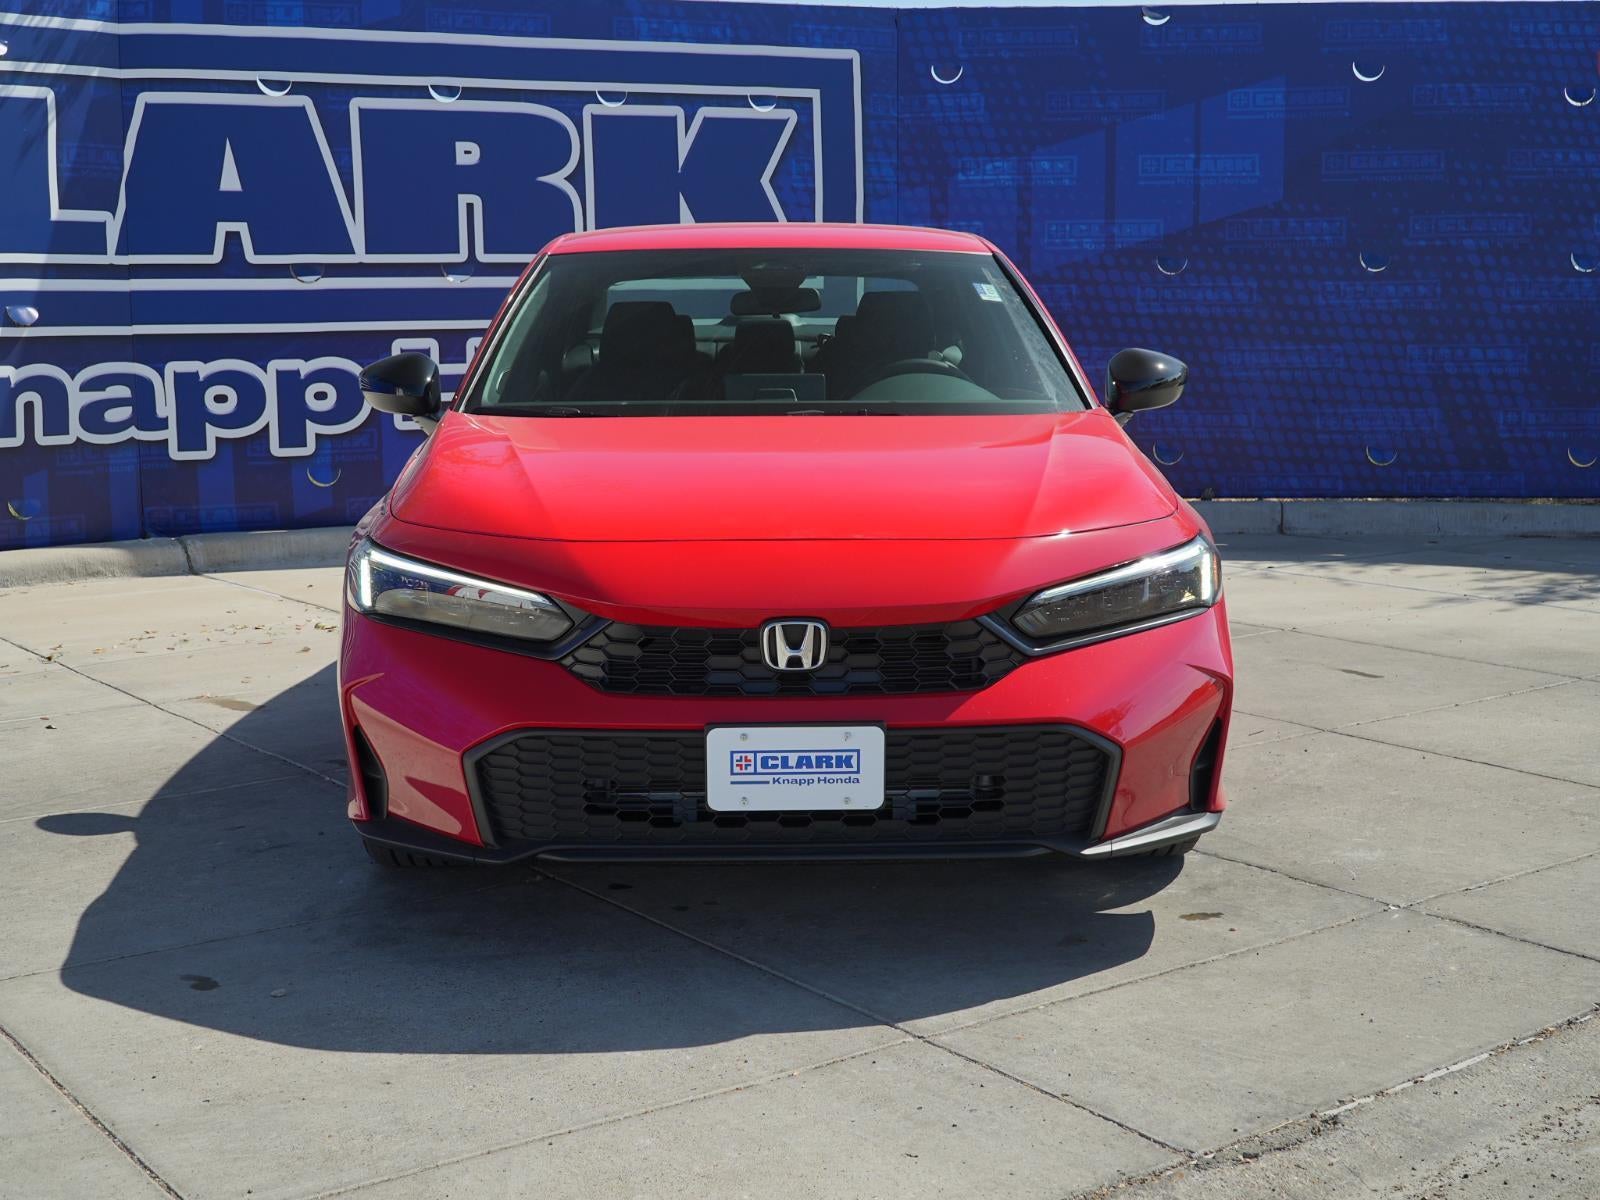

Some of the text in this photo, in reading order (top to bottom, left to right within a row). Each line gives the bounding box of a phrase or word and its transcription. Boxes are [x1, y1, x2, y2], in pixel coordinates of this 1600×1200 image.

[760, 754, 854, 770] CLARK
[772, 775, 860, 786] Knapp Honda
